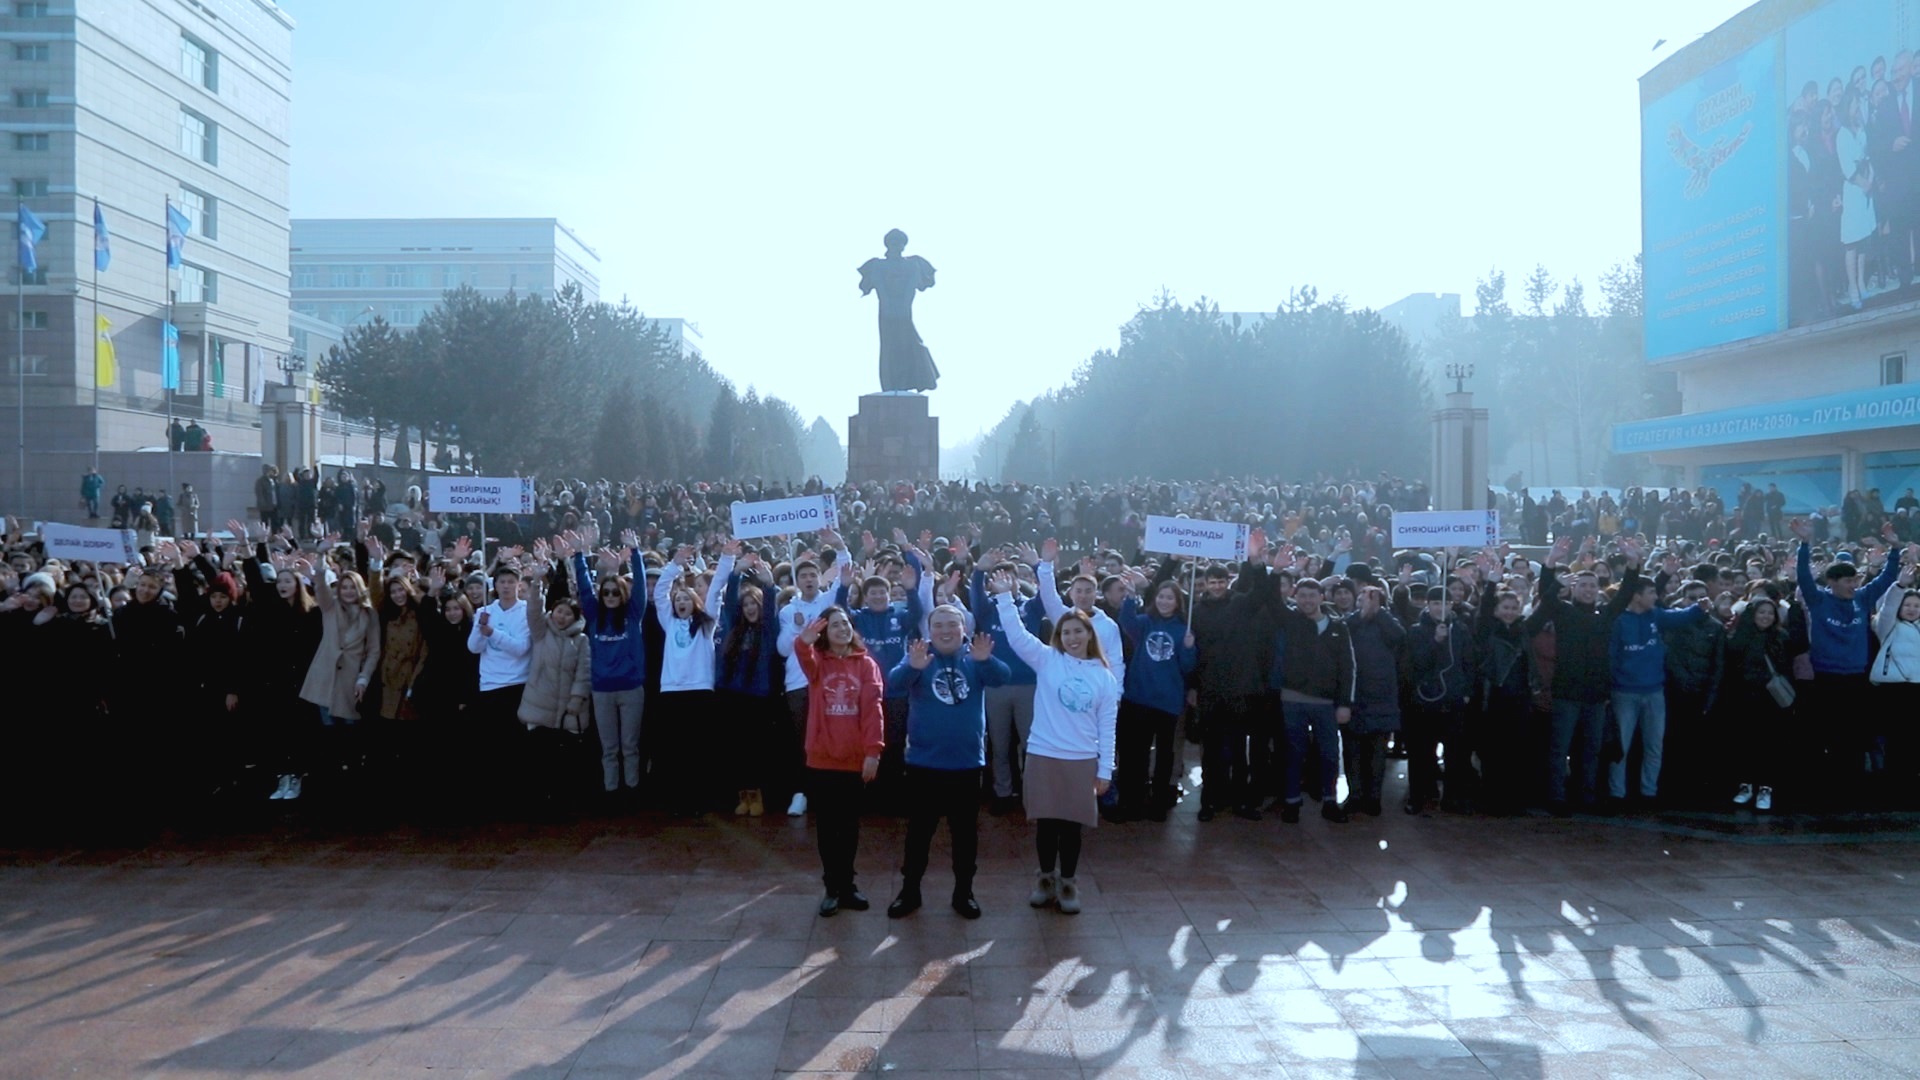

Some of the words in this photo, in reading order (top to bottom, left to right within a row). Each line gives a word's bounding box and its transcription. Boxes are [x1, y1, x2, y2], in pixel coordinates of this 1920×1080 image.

[1626, 426, 1683, 446] СТРАТЕГИЯ
[1812, 406, 1852, 424] ПУТЬ
[1855, 396, 1920, 418] МОЛОД
[450, 496, 501, 505] БОЛАЙЫҚ!
[740, 508, 818, 525] #AlFarabiQQ
[1158, 526, 1224, 540] ҚАЙЫРЫМДЫ
[1398, 524, 1451, 535] СИЯЮЩИЙ
[1452, 524, 1480, 533] СВЕТ!
[1178, 539, 1201, 549] БОЛ!
